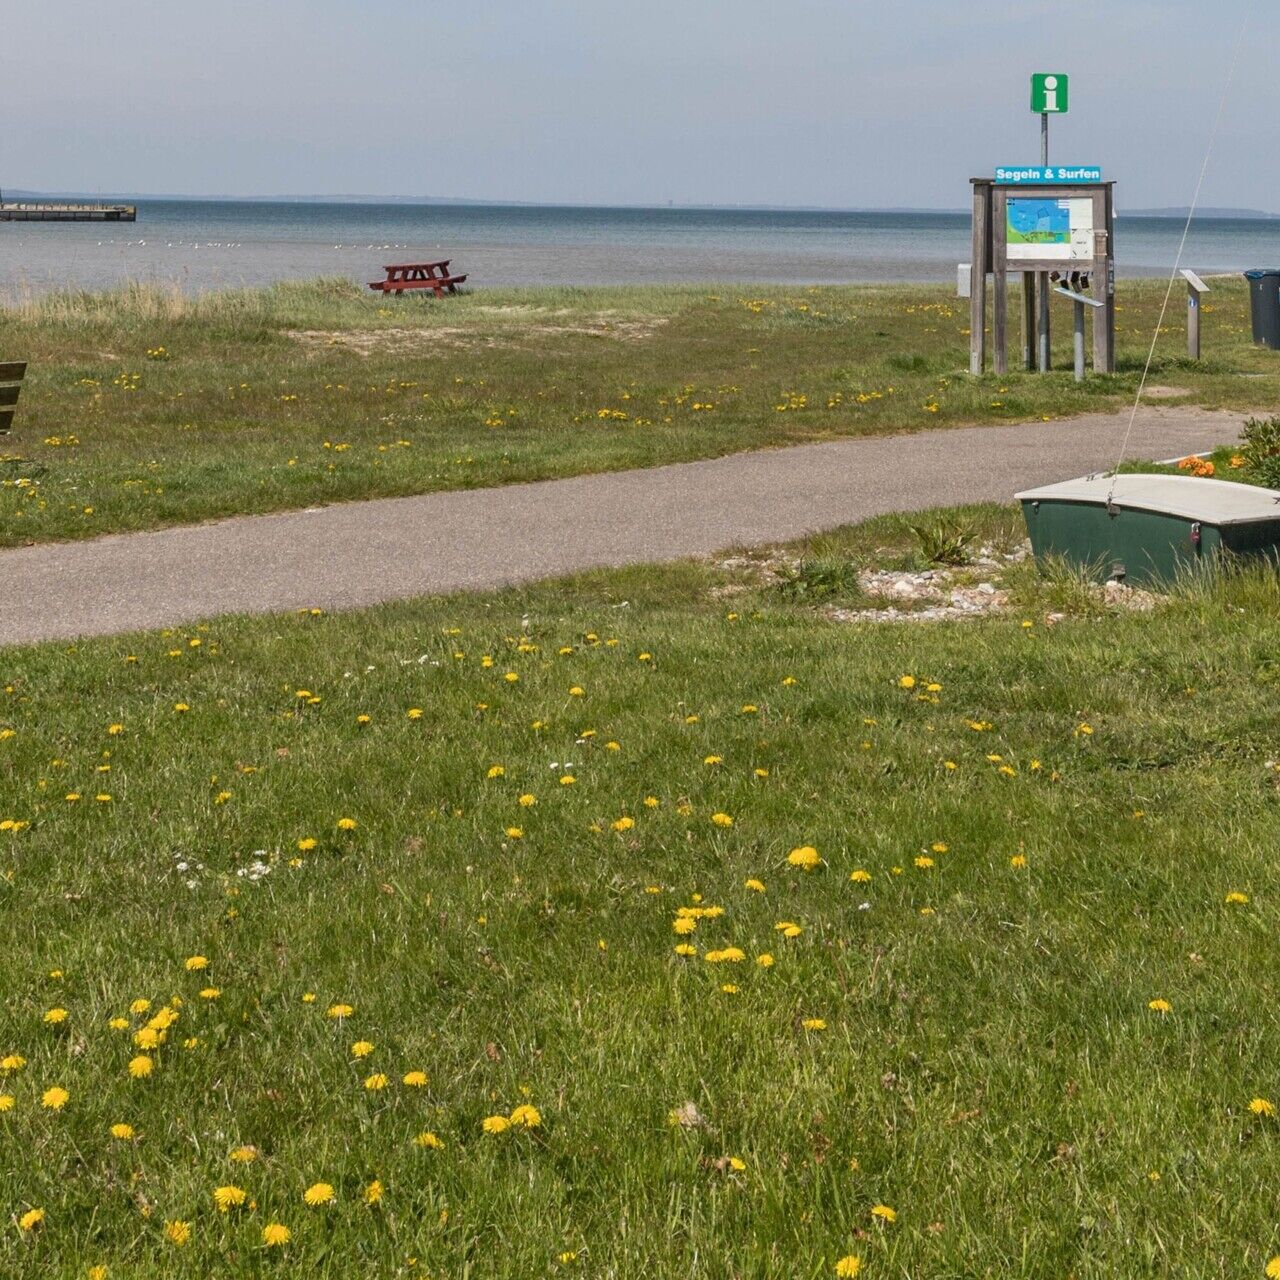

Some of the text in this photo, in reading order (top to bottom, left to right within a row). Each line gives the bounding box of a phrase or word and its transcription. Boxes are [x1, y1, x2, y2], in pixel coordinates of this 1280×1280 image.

[996, 168, 1100, 181] Segeln & Surfen
